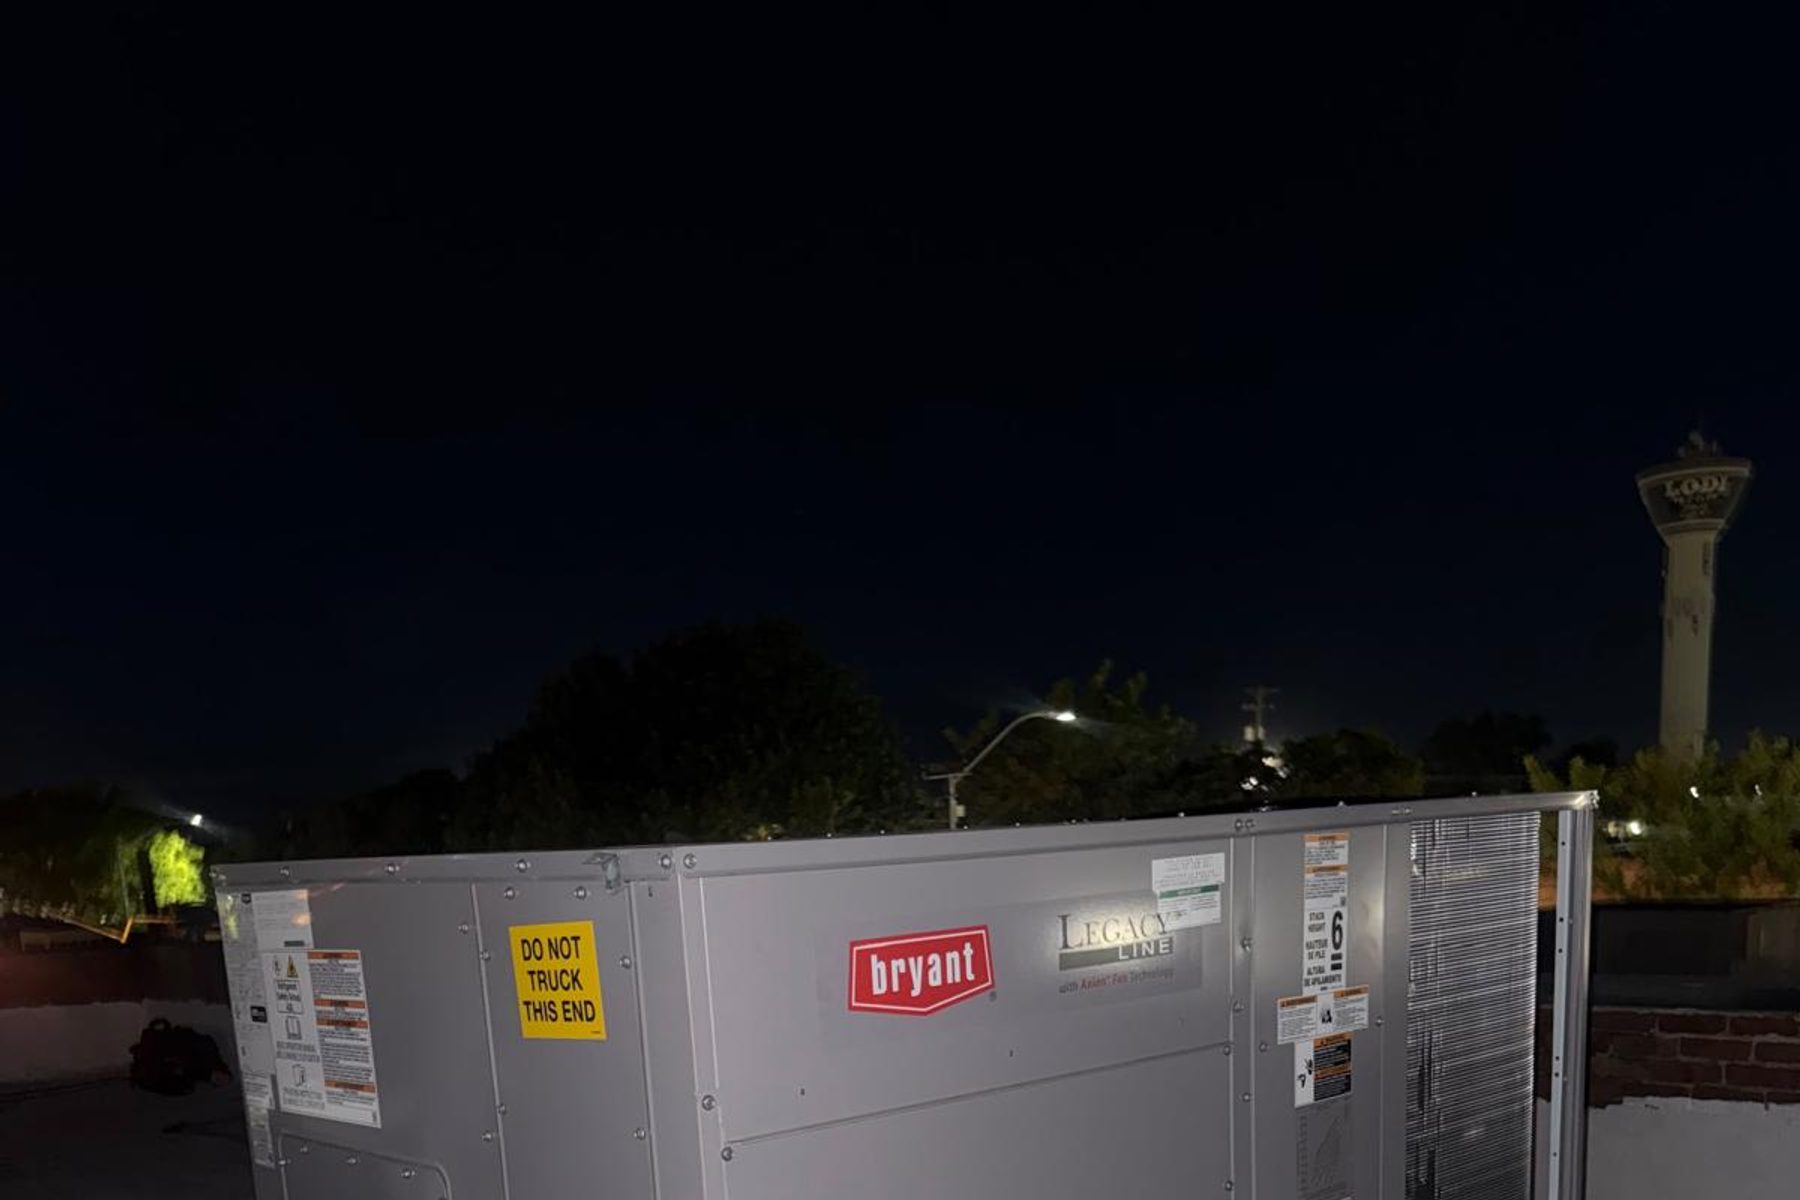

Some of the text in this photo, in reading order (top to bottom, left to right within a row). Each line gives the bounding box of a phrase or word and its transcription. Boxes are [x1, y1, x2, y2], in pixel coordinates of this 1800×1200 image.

[1056, 912, 1169, 950] LEGACY
[1331, 910, 1343, 950] 6
[520, 936, 581, 961] DO NOT
[1118, 938, 1171, 961] LINE
[527, 969, 584, 992] TRUCK
[870, 942, 975, 997] bryant
[1058, 980, 1078, 994] with
[1111, 971, 1128, 986] Fan
[1130, 968, 1174, 985] Technology
[523, 1000, 596, 1022] THIS END
